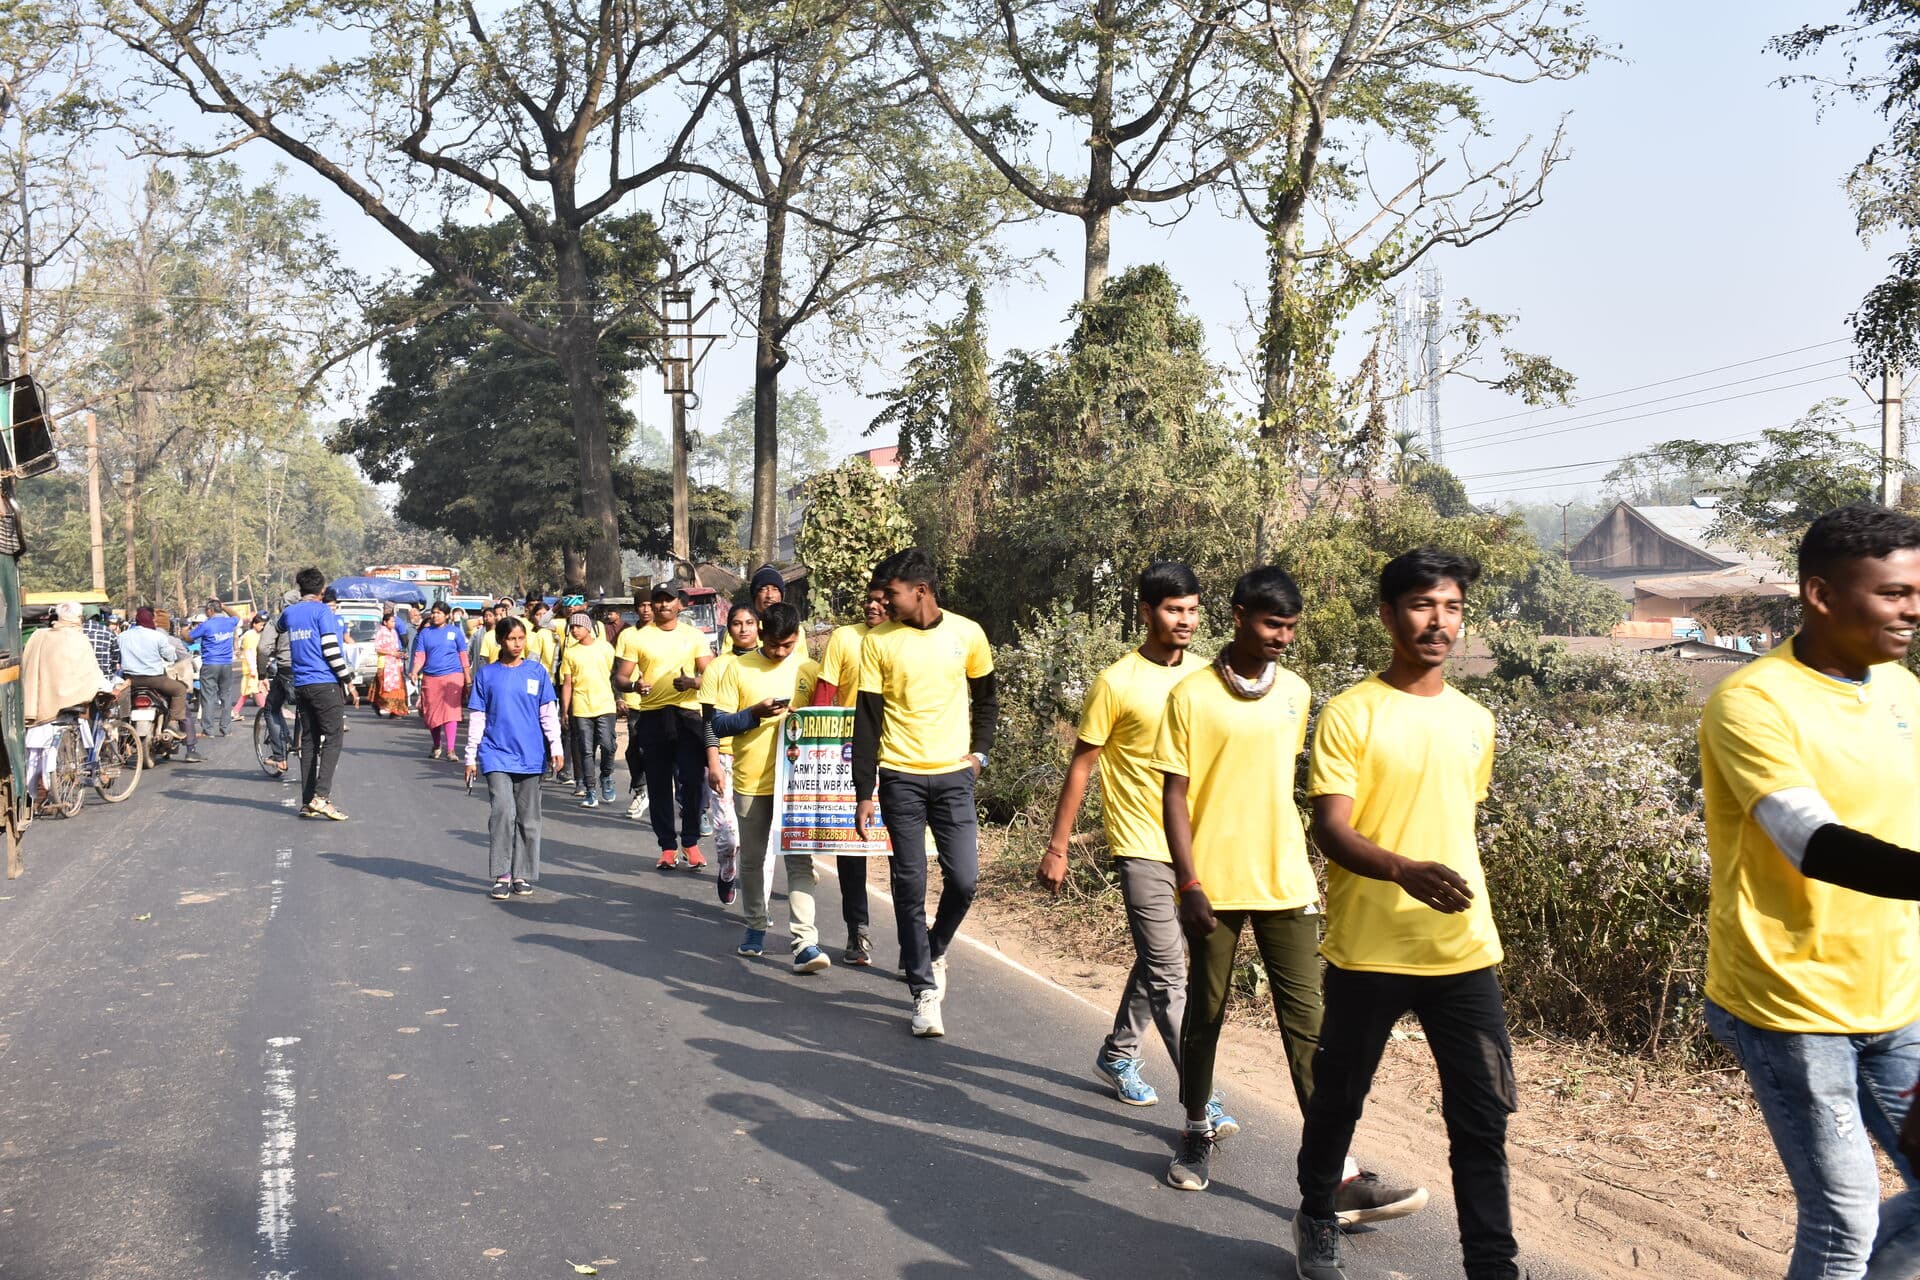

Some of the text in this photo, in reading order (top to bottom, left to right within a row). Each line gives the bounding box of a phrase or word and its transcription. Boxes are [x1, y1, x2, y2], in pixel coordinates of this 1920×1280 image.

[817, 764, 833, 776] BSF,
[835, 764, 850, 774] SSC
[823, 780, 842, 792] WBP,
